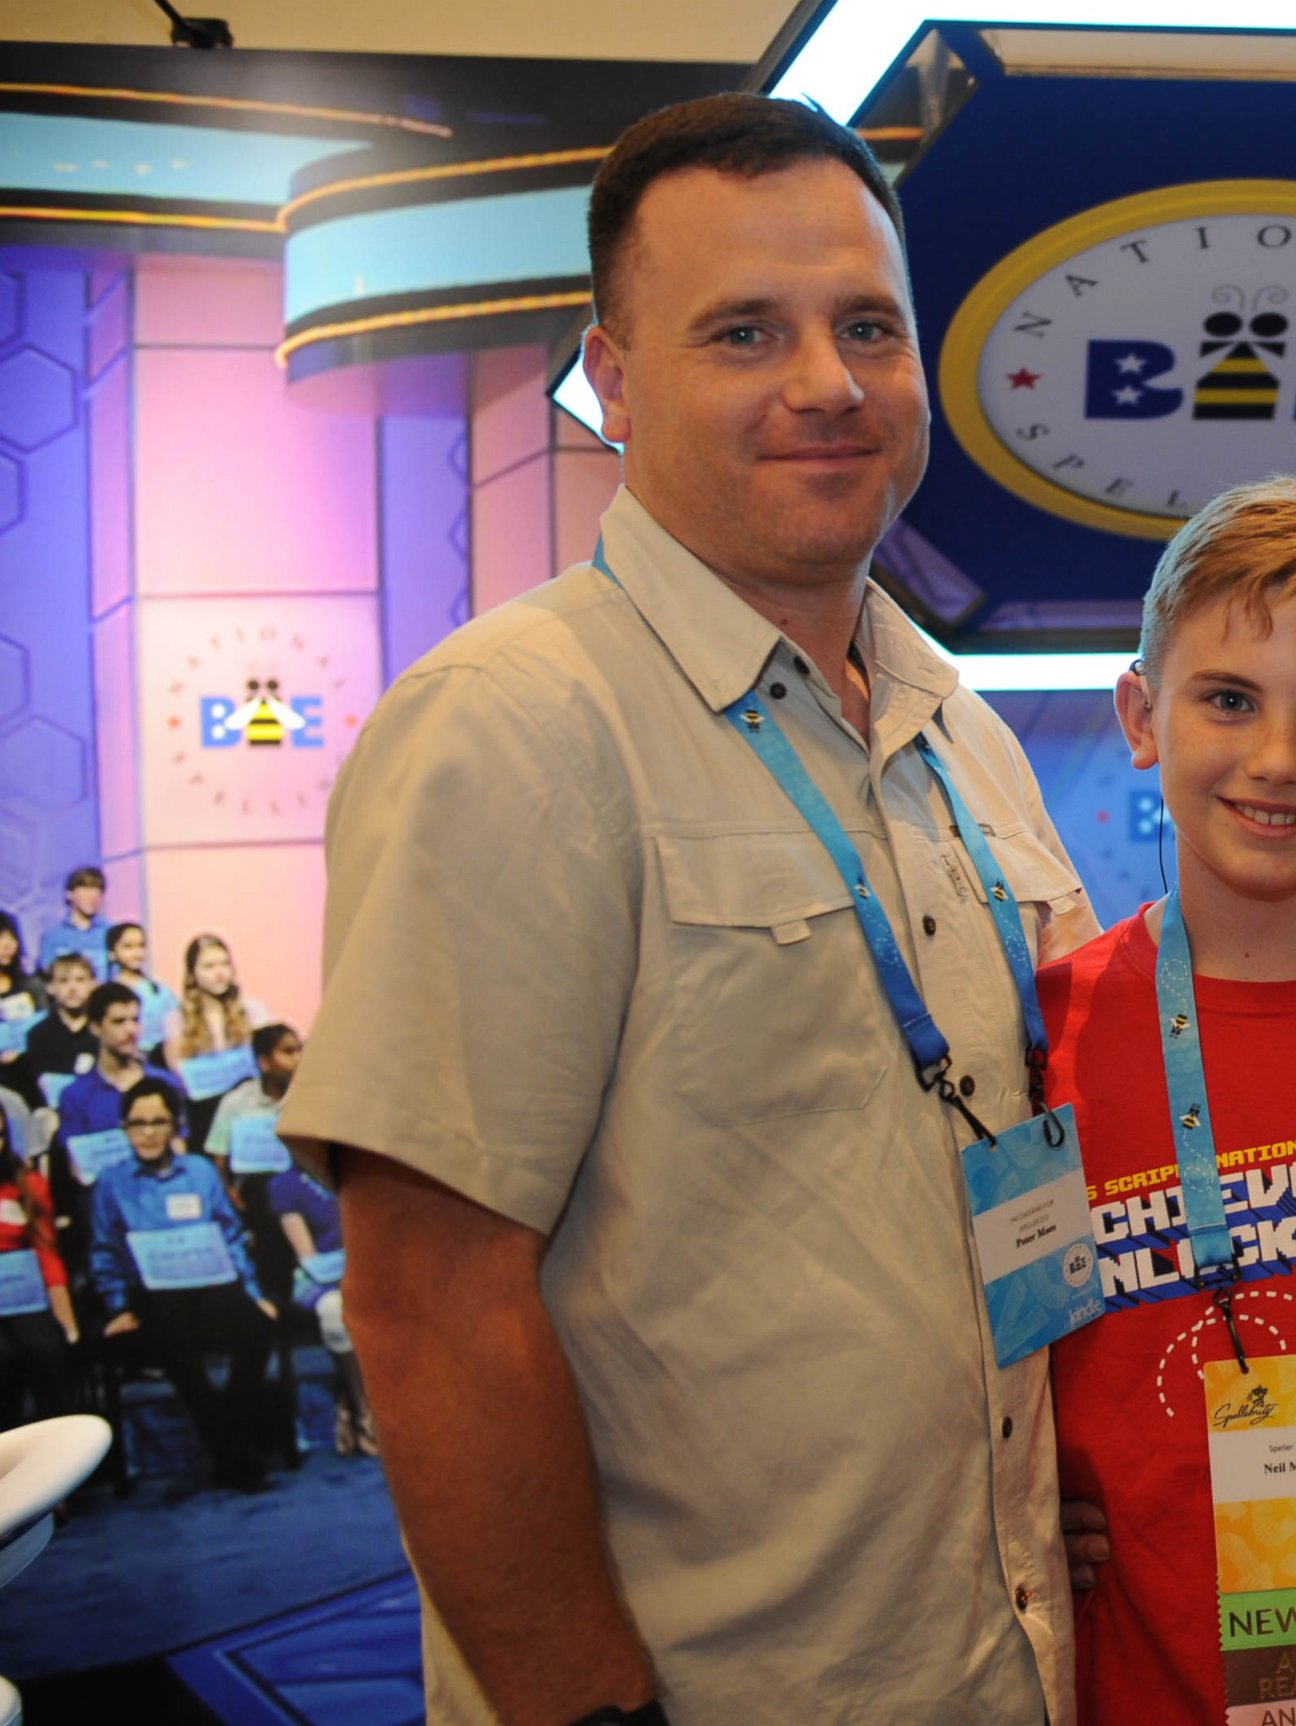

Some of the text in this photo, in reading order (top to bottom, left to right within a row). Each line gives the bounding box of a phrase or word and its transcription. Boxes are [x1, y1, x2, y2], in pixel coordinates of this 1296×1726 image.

[1104, 1164, 1180, 1196] SCRIP
[1268, 1443, 1294, 1454] Speller
[1264, 1462, 1286, 1475] Neil
